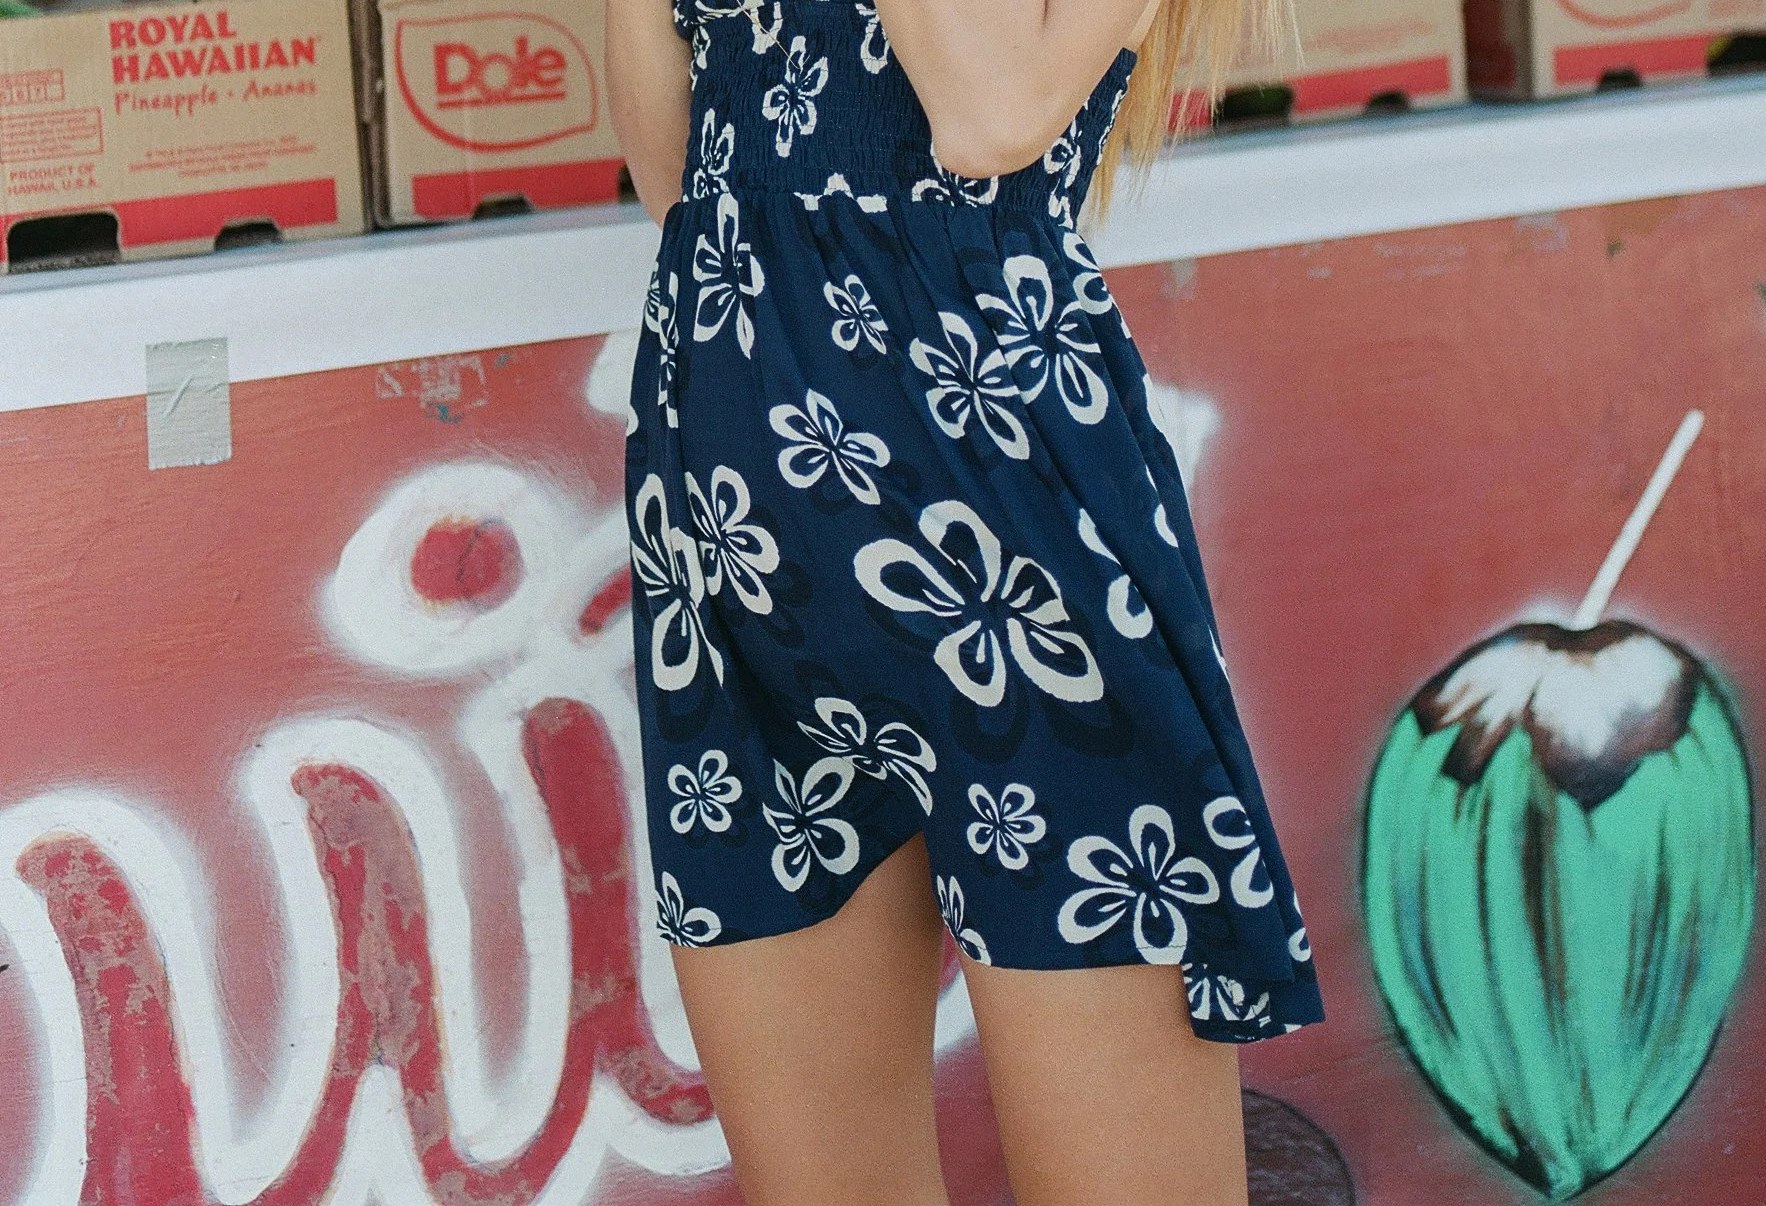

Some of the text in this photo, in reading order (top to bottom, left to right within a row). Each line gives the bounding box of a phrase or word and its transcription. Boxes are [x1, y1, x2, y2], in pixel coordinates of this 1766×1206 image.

[110, 11, 236, 49] ROYAL
[111, 37, 317, 85] HAWAIIAN
[433, 35, 567, 96] Dole
[114, 80, 317, 116] Pineapple Ananas
[10, 162, 95, 182] PRODUCT OF
